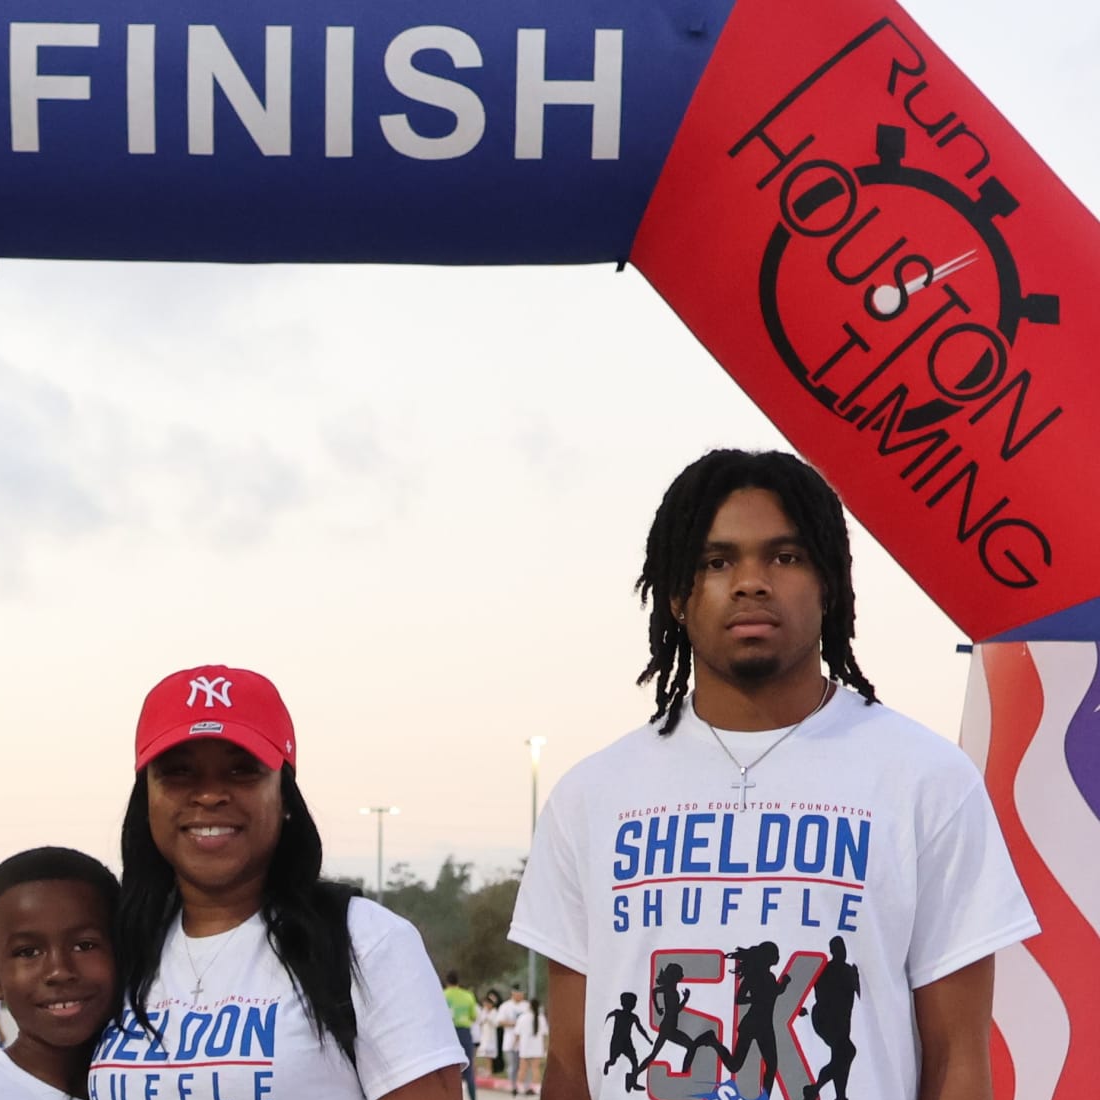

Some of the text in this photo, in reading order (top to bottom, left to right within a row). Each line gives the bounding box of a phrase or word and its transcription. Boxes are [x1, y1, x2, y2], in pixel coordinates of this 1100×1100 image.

[727, 122, 1063, 462] HOUSTON
[810, 320, 1053, 590] TIMING
[186, 675, 233, 708] NY
[618, 806, 667, 821] SHELDON
[677, 802, 699, 813] ISD
[791, 801, 873, 819] FOUNDATION
[613, 812, 872, 882] SHELDON
[613, 887, 863, 933] SHUFFLE
